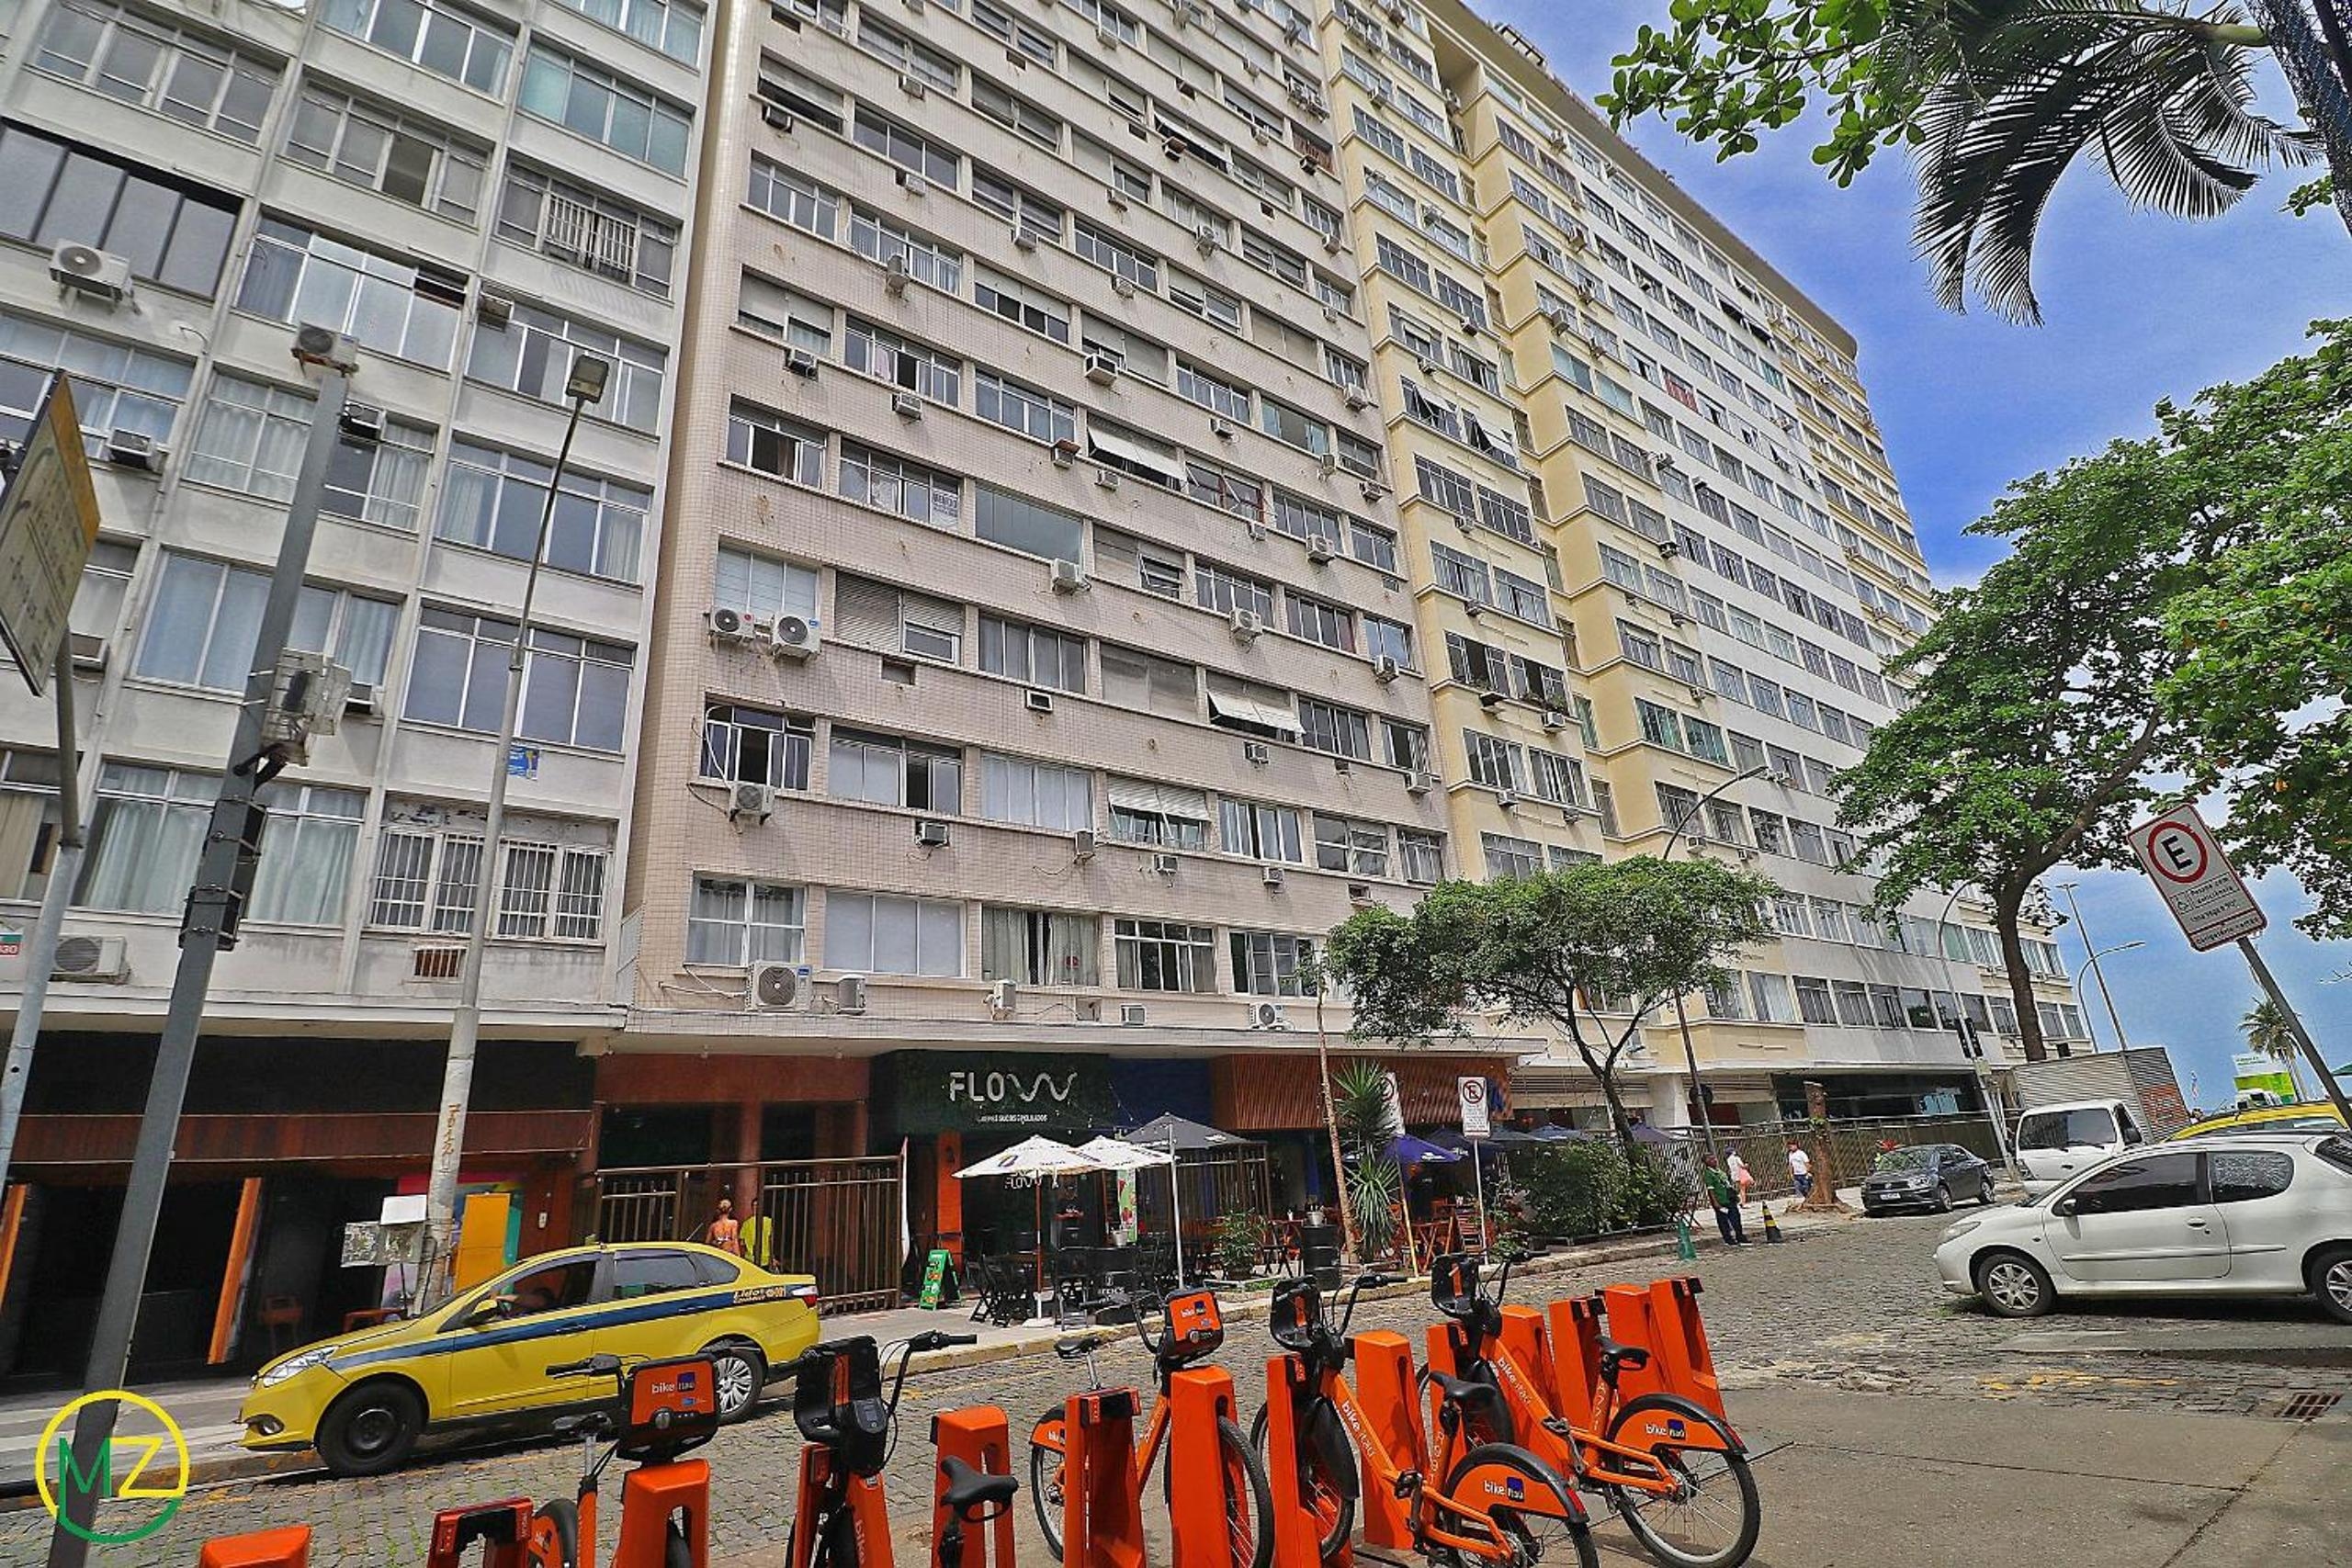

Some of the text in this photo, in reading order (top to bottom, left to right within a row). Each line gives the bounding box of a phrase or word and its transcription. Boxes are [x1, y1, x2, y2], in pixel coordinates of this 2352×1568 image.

[2161, 835, 2194, 871] E
[949, 1071, 1078, 1102] FLOW
[1498, 1356, 1518, 1384] bike
[651, 1382, 675, 1394] bike
[1341, 1399, 1361, 1432] bike
[1645, 1422, 1668, 1435] bike
[1483, 1479, 1506, 1496] bike
